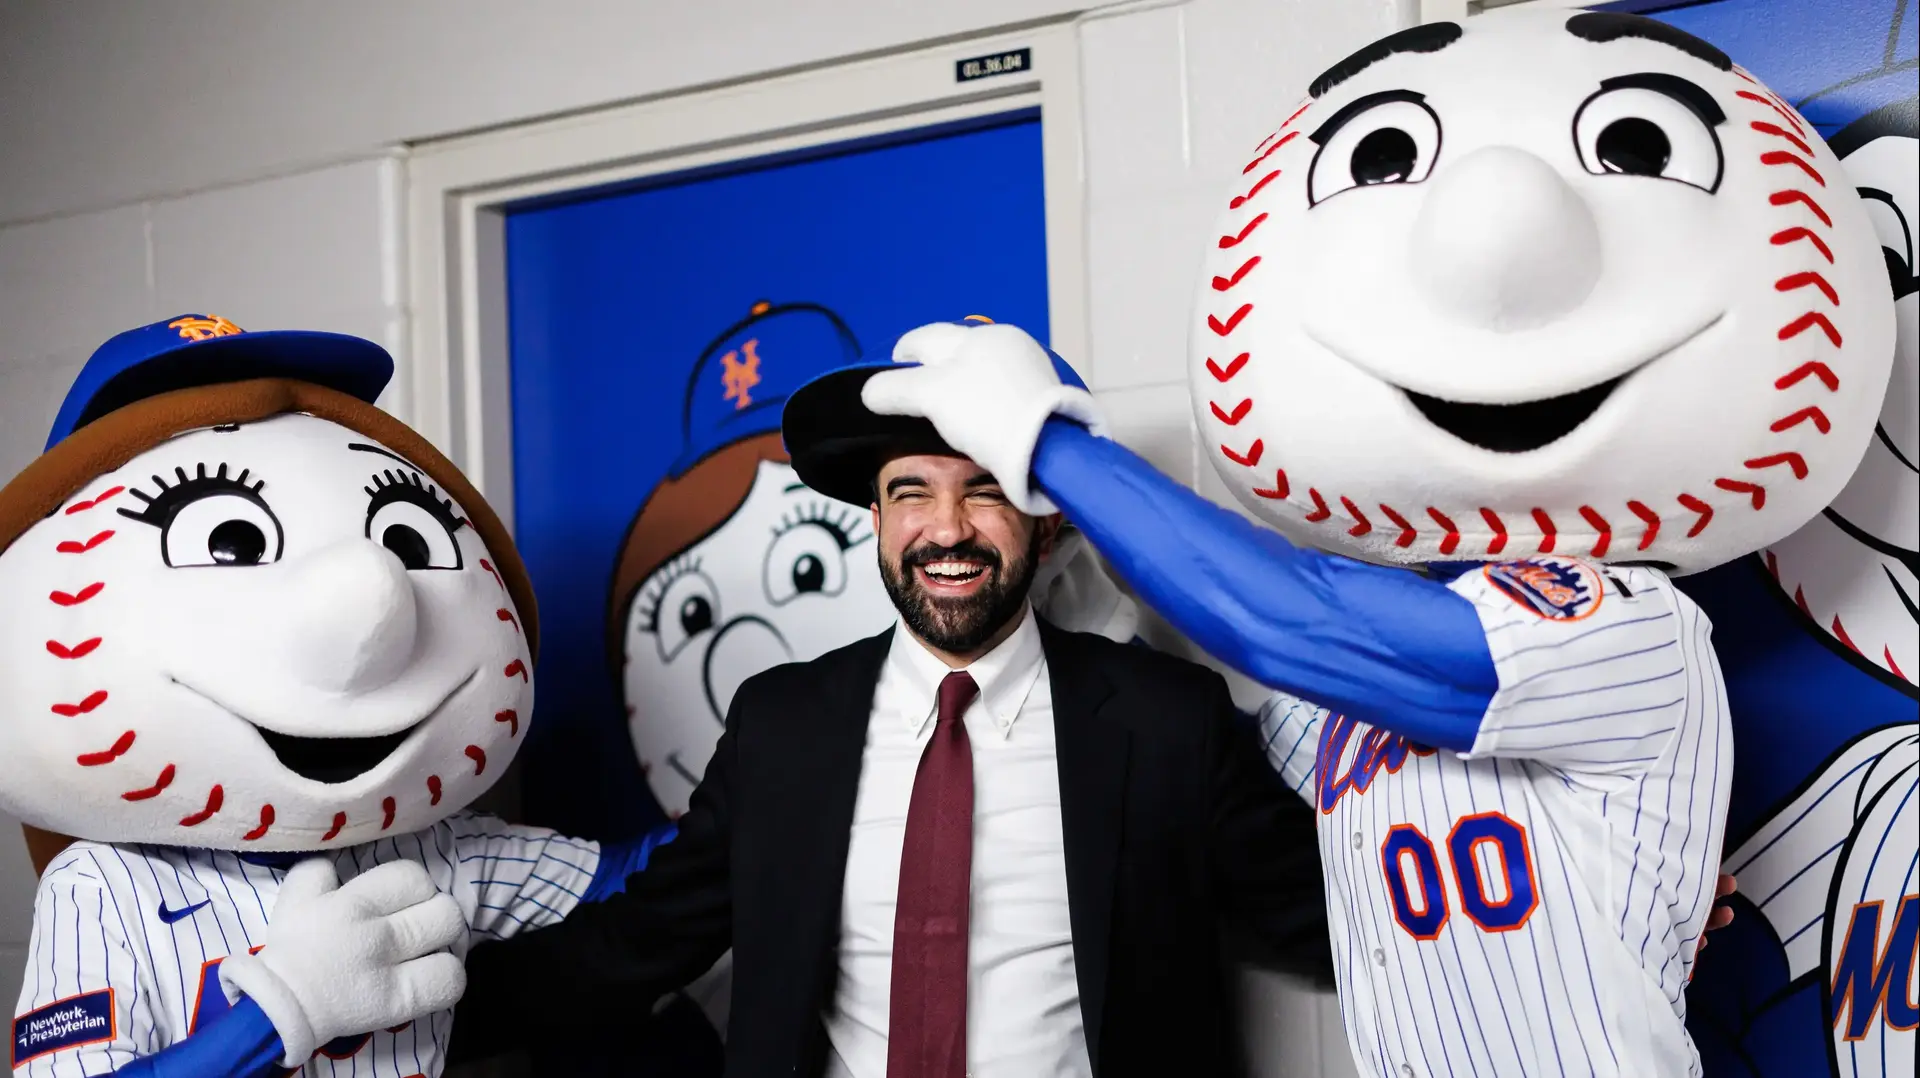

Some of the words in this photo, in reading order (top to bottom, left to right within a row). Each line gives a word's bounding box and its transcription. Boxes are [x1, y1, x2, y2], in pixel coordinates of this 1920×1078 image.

[1381, 811, 1539, 941] 00
[30, 1006, 87, 1033] NewYork-
[30, 1016, 105, 1044] Presbyterian
